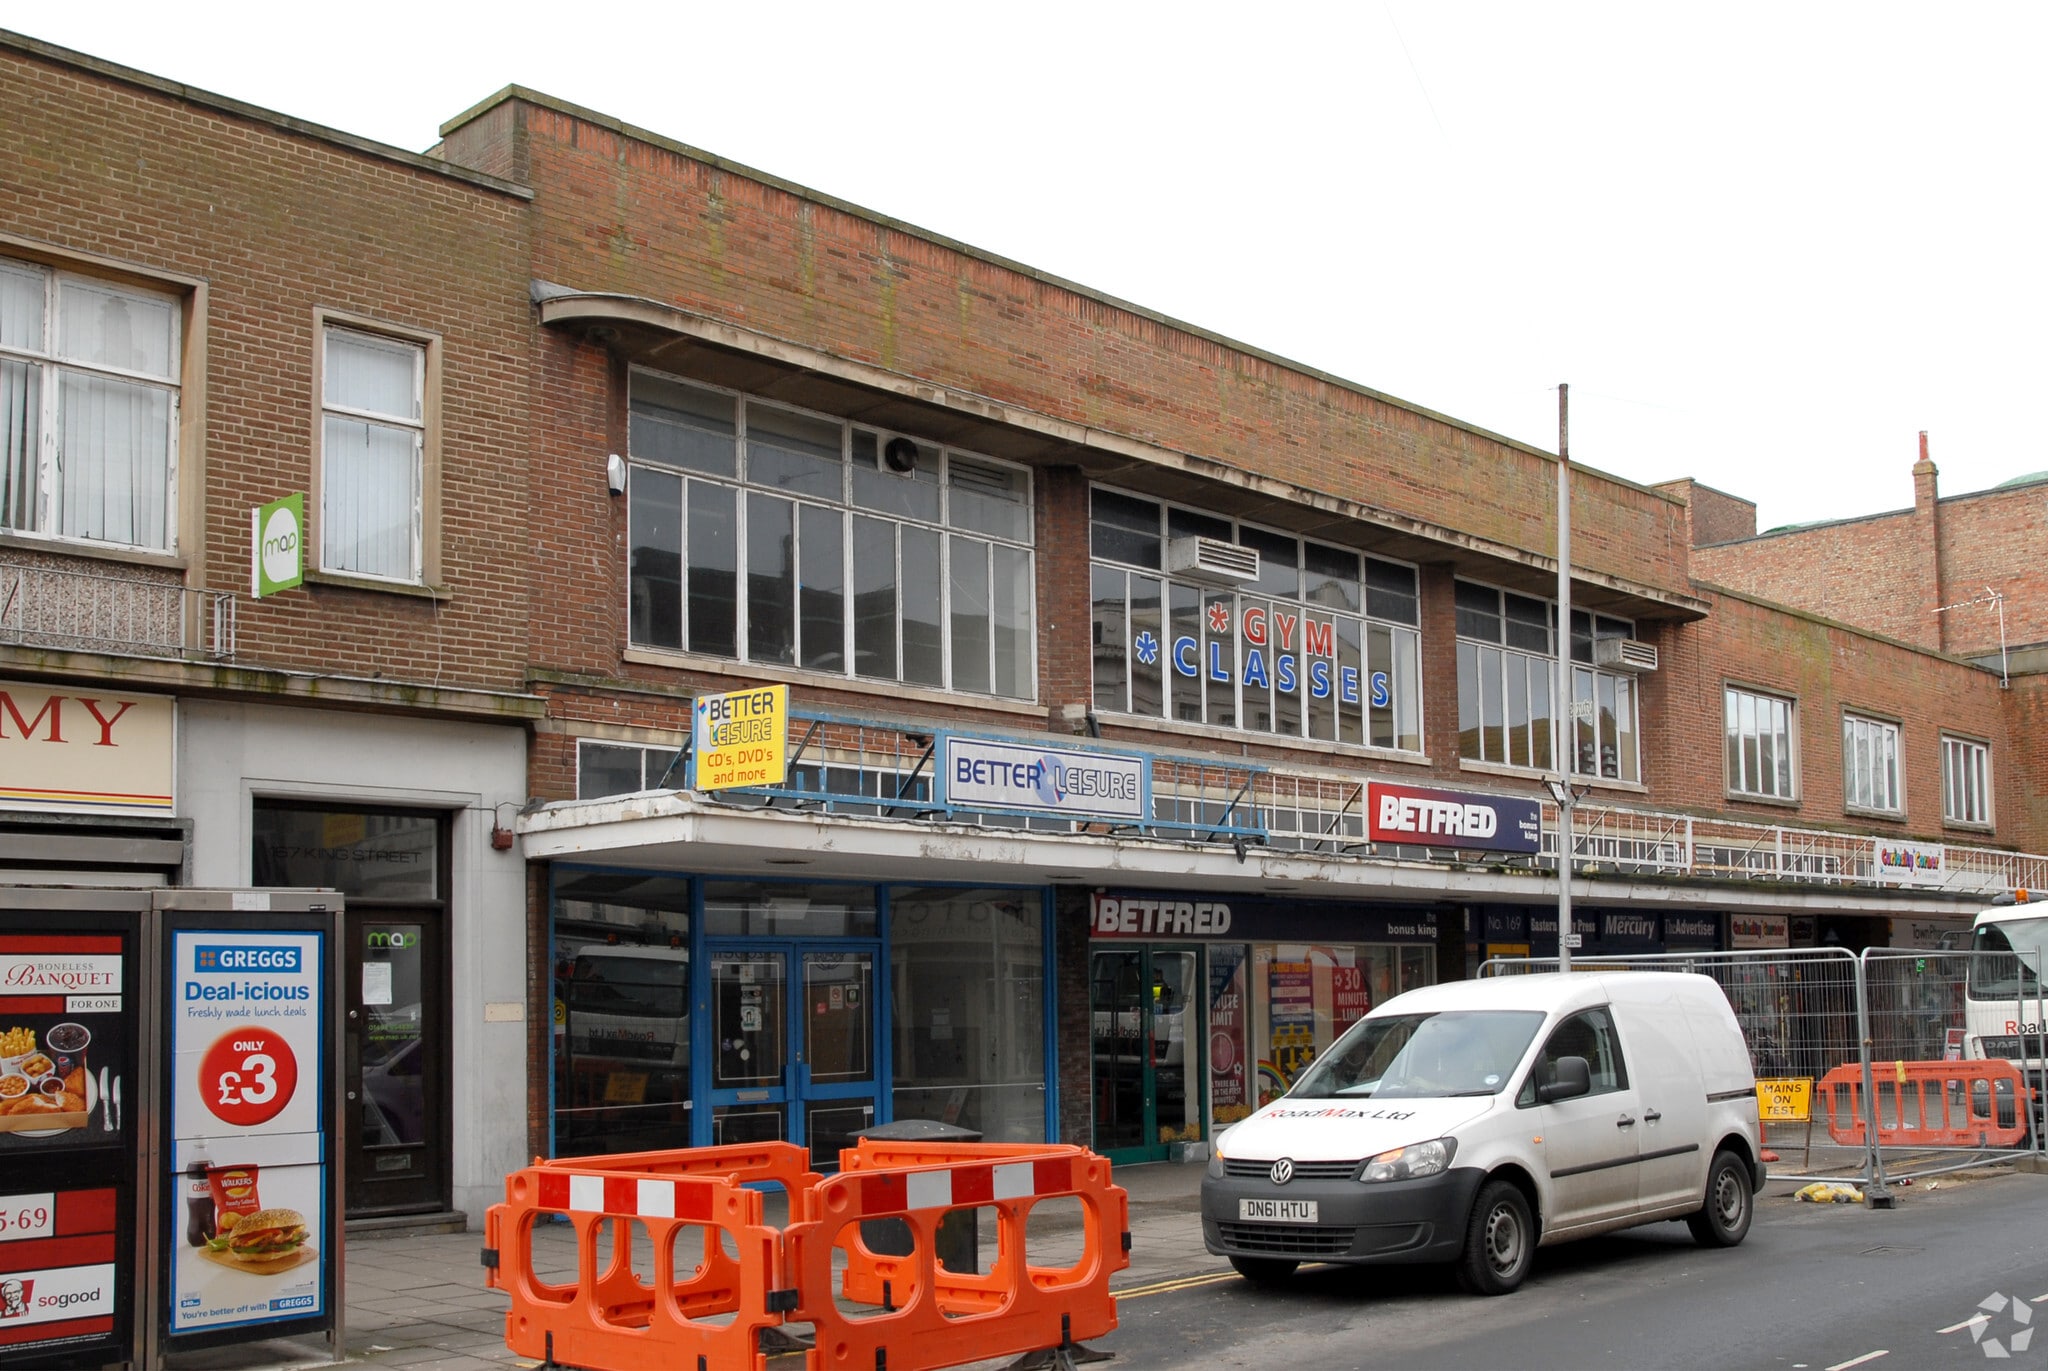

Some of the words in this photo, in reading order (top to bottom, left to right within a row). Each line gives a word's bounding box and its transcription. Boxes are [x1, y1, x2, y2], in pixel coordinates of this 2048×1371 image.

[264, 532, 297, 558] map
[1242, 607, 1334, 659] GYM
[1172, 636, 1389, 708] CLASSES
[710, 691, 774, 721] BETTER
[709, 717, 772, 747] LEISURE
[738, 748, 773, 765] DVD's
[713, 769, 734, 784] and
[737, 769, 766, 782] more
[956, 755, 1041, 791] BETTER
[1054, 761, 1138, 801] LEISURE
[1378, 793, 1497, 840] BETFRED
[1518, 819, 1538, 830] bonus
[1524, 830, 1538, 842] king
[304, 848, 349, 861] KING
[352, 850, 423, 864] STREET
[1098, 898, 1232, 935] BETFRED
[1488, 915, 1503, 930] No.
[1505, 915, 1521, 930] 169
[1387, 922, 1416, 935] bonus
[1417, 923, 1437, 938] king
[1530, 917, 1557, 933] Eastern
[1577, 918, 1596, 933] Press
[1605, 914, 1655, 940] Mercury
[367, 931, 417, 949] map
[37, 962, 94, 971] BONELESS
[220, 950, 297, 968] GREGGS
[4, 963, 114, 990] BANQUET
[1344, 968, 1361, 990] 30
[184, 981, 310, 1001] Deal-icious
[1338, 992, 1369, 1006] MINUTE
[71, 1000, 93, 1009] FOR
[95, 1000, 118, 1008] ONE
[187, 1006, 222, 1020] Freshly
[225, 1006, 251, 1017] made
[254, 1005, 281, 1017] lunch
[283, 1005, 307, 1017] deals
[1342, 1007, 1364, 1022] LIMIT
[233, 1041, 265, 1052] ONLY
[218, 1053, 277, 1105] £3
[1763, 1083, 1802, 1094] MAINS
[1773, 1095, 1791, 1105] ON
[1261, 1108, 1371, 1120] RoadMax
[1373, 1109, 1416, 1121] Ltd
[1766, 1105, 1796, 1116] TEST
[221, 1177, 253, 1188] WALKERS
[1247, 1200, 1277, 1218] DN61
[1280, 1201, 1309, 1219] HTU
[181, 1310, 208, 1320] You're
[209, 1307, 234, 1316] better
[236, 1304, 248, 1313] off
[250, 1303, 267, 1312] with
[279, 1296, 312, 1309] GREGGS
